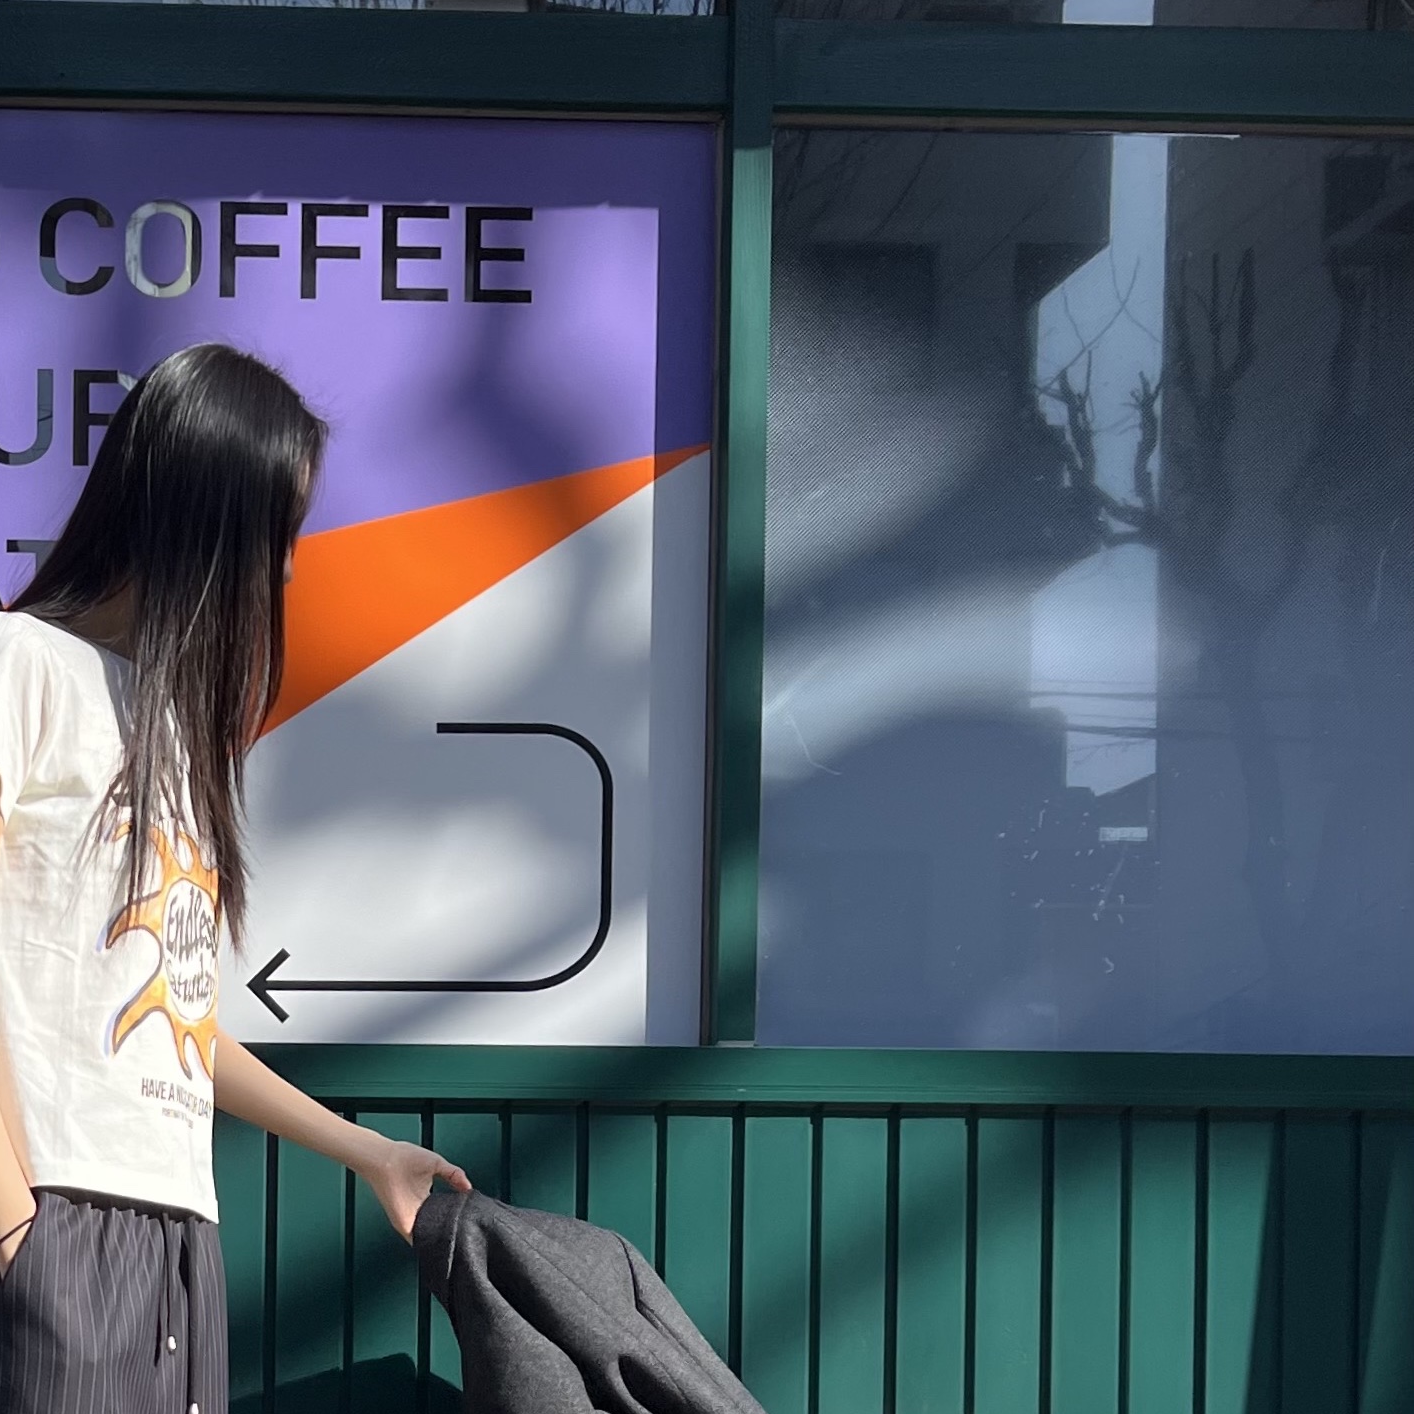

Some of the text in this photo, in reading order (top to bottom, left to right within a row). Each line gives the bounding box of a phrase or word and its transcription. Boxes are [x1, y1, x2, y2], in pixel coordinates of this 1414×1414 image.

[39, 197, 534, 304] COFFEE
[141, 1077, 167, 1100] HAVE
[167, 1082, 175, 1101] A
